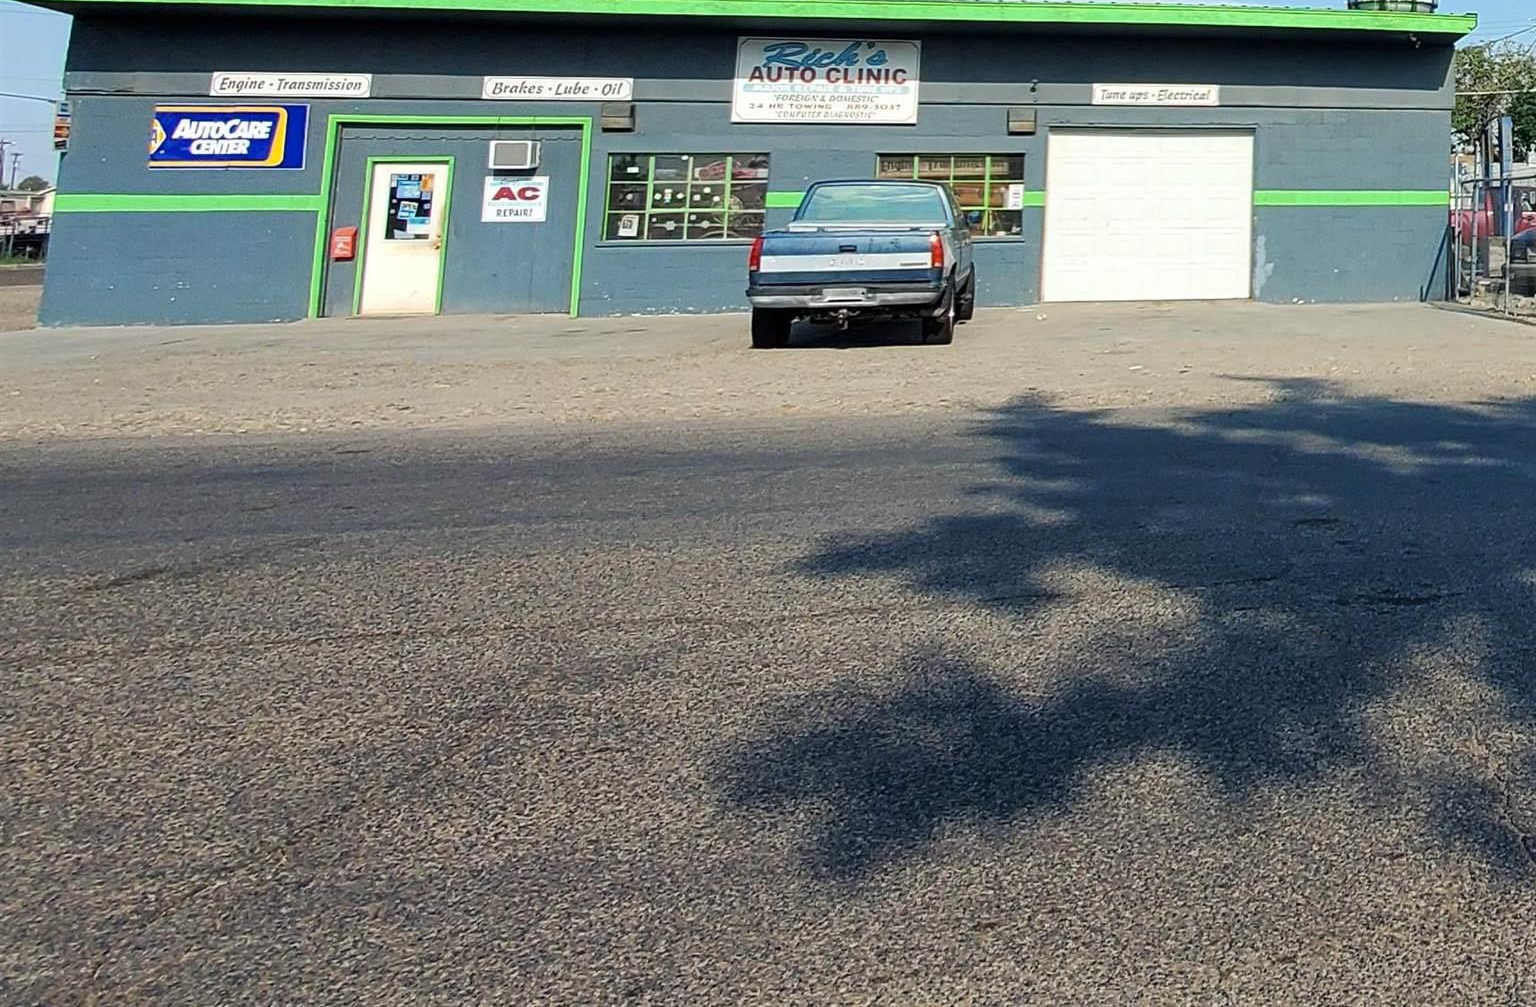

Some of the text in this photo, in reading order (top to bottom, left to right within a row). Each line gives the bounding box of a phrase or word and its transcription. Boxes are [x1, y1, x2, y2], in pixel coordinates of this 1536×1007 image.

[762, 42, 889, 69] Rich's
[748, 66, 908, 85] AUTO CLINIC
[219, 77, 266, 92] Engine
[277, 78, 362, 91] Transmission
[492, 81, 544, 95] Brakes
[555, 82, 590, 96] Lube
[601, 82, 623, 96] Oil
[1101, 89, 1128, 101] Tune
[1129, 90, 1150, 101] ups
[1157, 89, 1211, 101] Electrical
[190, 139, 250, 154] CENTER
[491, 186, 541, 201] AC
